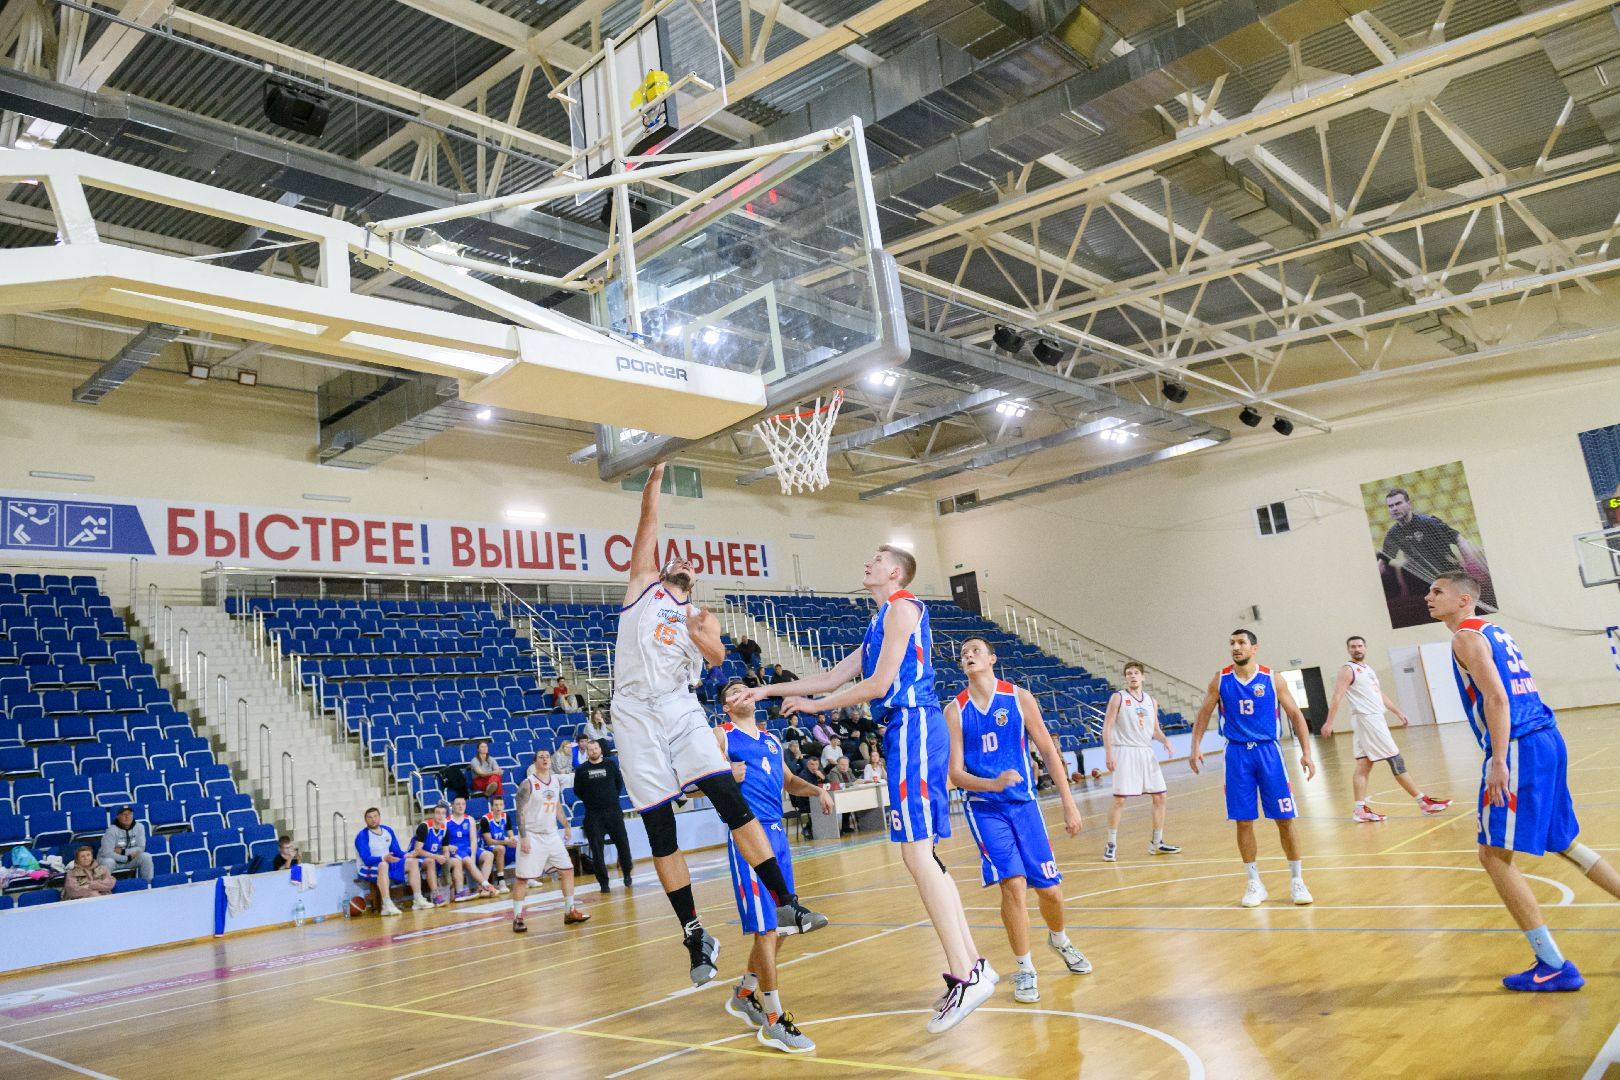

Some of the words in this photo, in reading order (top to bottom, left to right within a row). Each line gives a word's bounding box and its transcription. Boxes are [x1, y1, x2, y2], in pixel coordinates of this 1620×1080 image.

[168, 507, 430, 565] БЫСТРЕЕ!
[450, 526, 588, 571] ВЫШЕ!
[604, 534, 768, 577] СЛЬНЕЕ!
[654, 623, 678, 645] 15
[1239, 699, 1254, 715] 13
[981, 731, 999, 753] 10
[761, 756, 772, 774] 4
[543, 801, 557, 813] 77
[1278, 797, 1292, 812] 13
[890, 809, 902, 831] 6
[1040, 860, 1057, 880] 10
